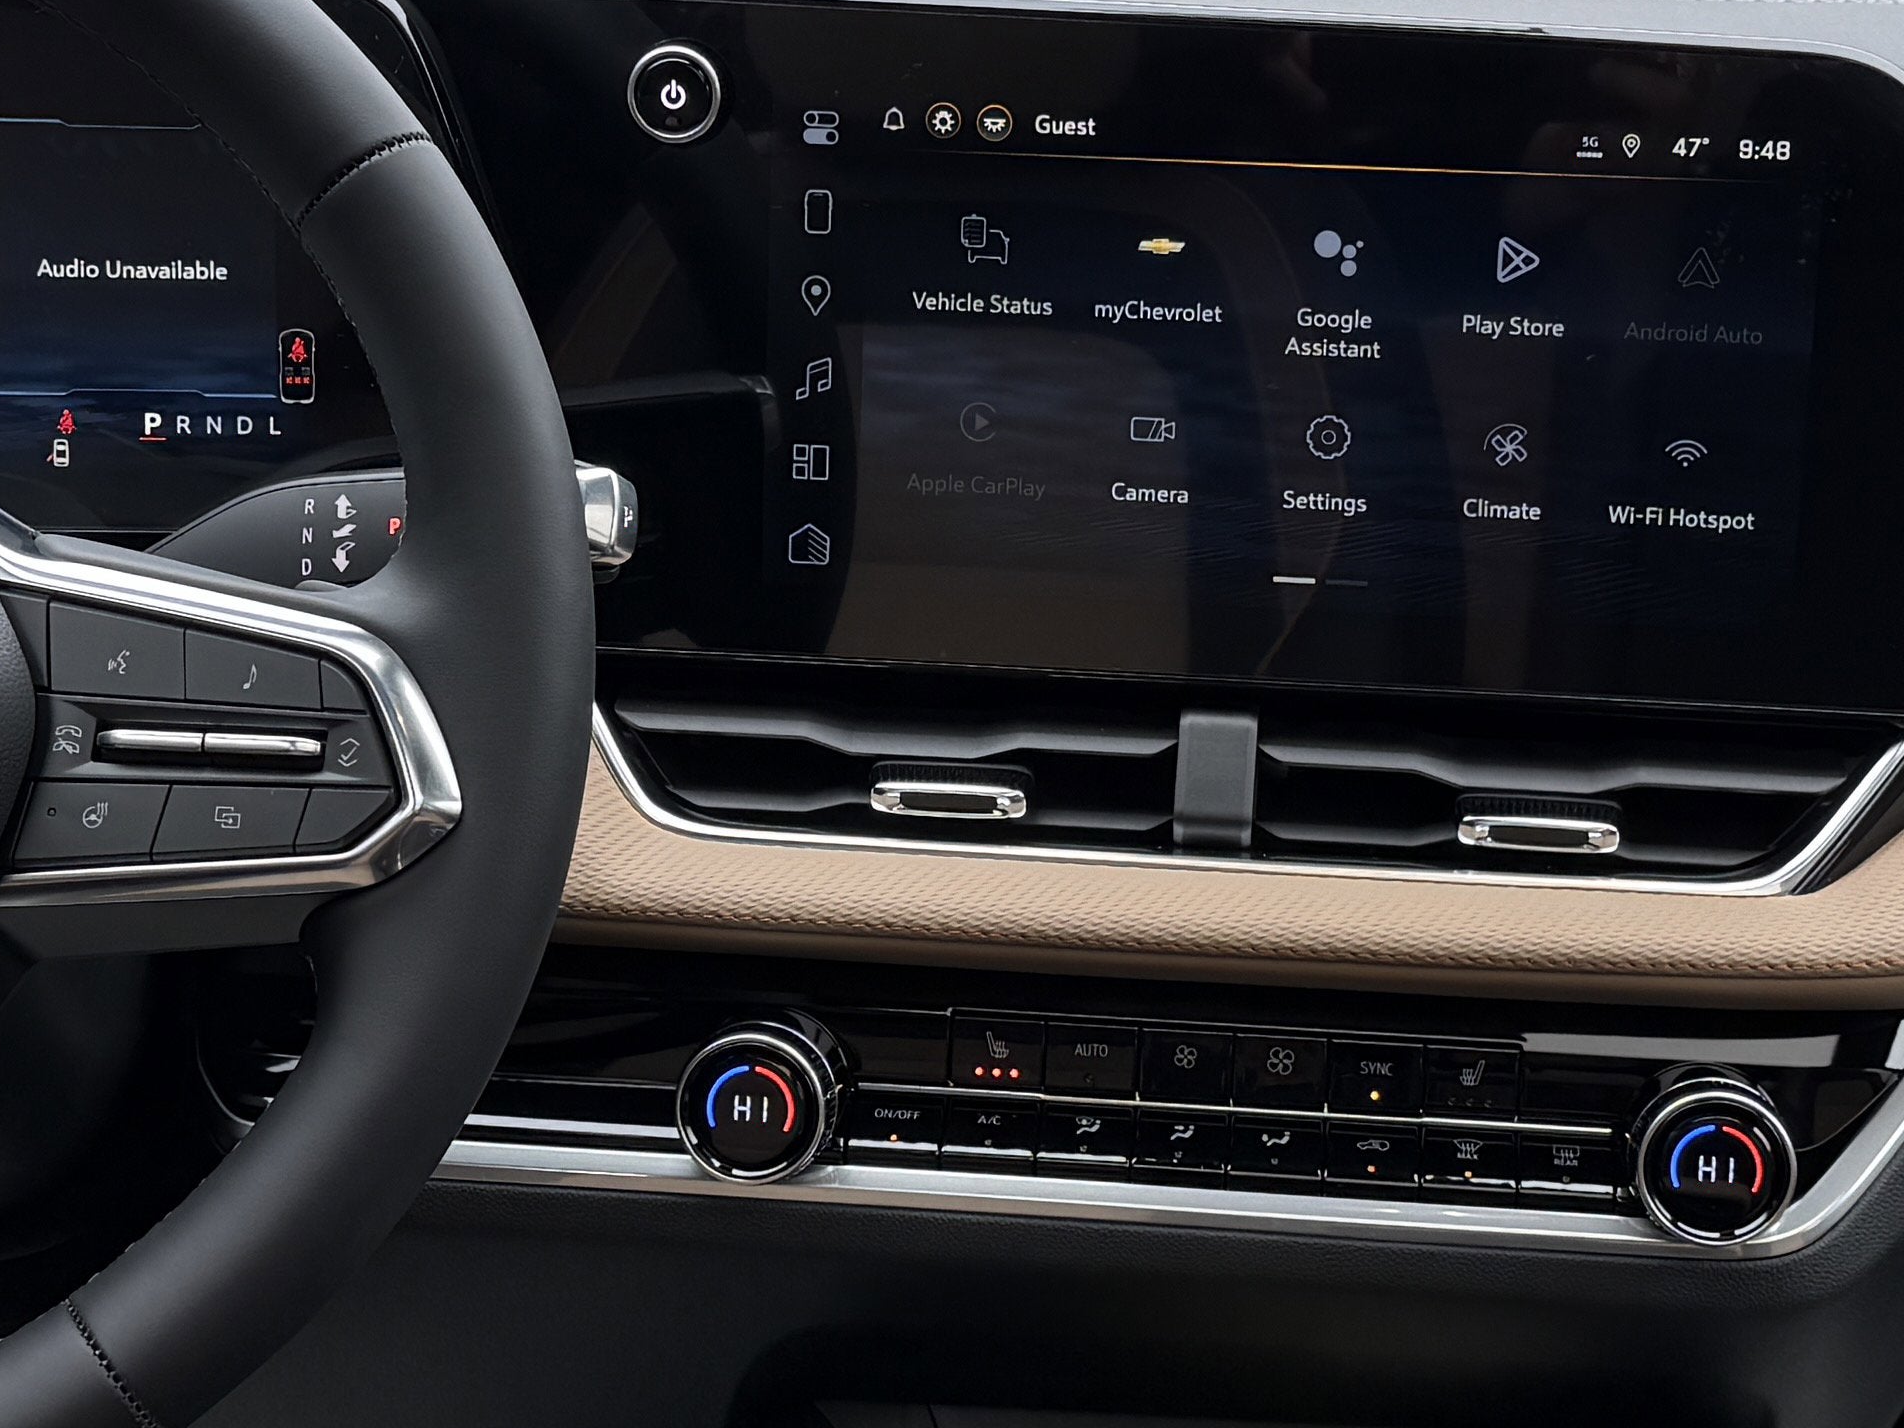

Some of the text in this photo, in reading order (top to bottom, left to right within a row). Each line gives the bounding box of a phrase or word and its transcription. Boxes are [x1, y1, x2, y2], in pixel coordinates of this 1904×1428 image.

[1034, 113, 1096, 137] Guest
[1582, 136, 1598, 148] 5G
[1672, 137, 1709, 157] 47°
[1739, 139, 1791, 160] 9:48
[37, 258, 228, 281] Audio Unavailable
[912, 291, 1053, 316] Vehicle Status
[1094, 299, 1223, 324] myChevrolet
[1296, 307, 1373, 333] Google
[1462, 315, 1565, 340] Play Store
[1624, 321, 1763, 346] Android Auto
[1284, 336, 1381, 359] Assistant
[144, 412, 282, 436] P R N D L
[906, 473, 1046, 500] Apple CarPlay
[1111, 483, 1189, 505] Camera
[304, 498, 315, 515] R
[1282, 491, 1367, 516] Settings
[1463, 499, 1542, 521] Climate
[388, 517, 401, 535] P
[1609, 505, 1755, 534] Wi-Fi Hotspot
[302, 527, 313, 545] N
[301, 558, 312, 576] D
[1074, 1042, 1108, 1058] AUTO
[1360, 1061, 1393, 1077] SYNC
[732, 1094, 768, 1123] HI
[874, 1107, 921, 1121] ON/OFF
[977, 1113, 1001, 1127] A/C
[1697, 1154, 1736, 1183] HI
